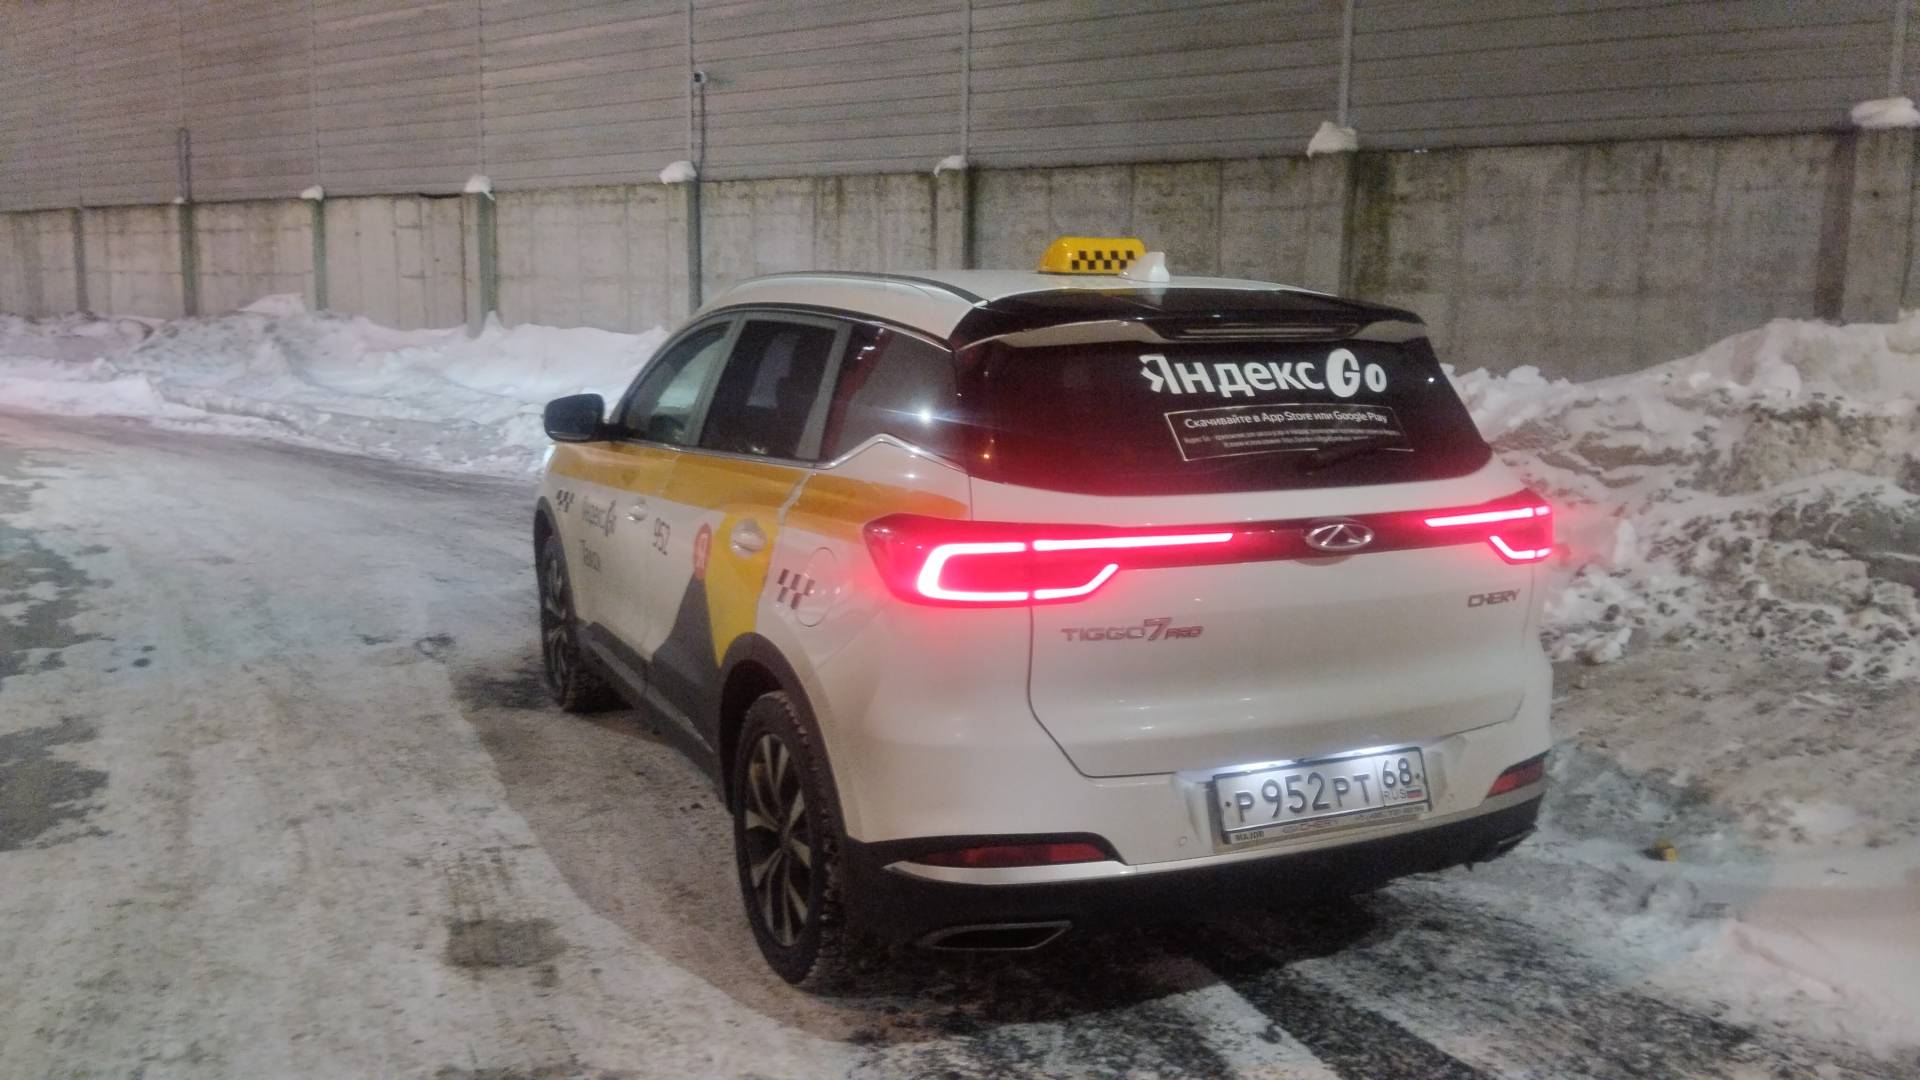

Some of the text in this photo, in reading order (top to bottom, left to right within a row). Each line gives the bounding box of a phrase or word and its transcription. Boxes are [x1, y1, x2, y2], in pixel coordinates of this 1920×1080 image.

[1139, 348, 1387, 398] Яндекс Go
[1184, 411, 1388, 428] Скачивайте в App Store или Google Play
[1467, 587, 1520, 608] CHERY
[1384, 791, 1408, 801] RUS
